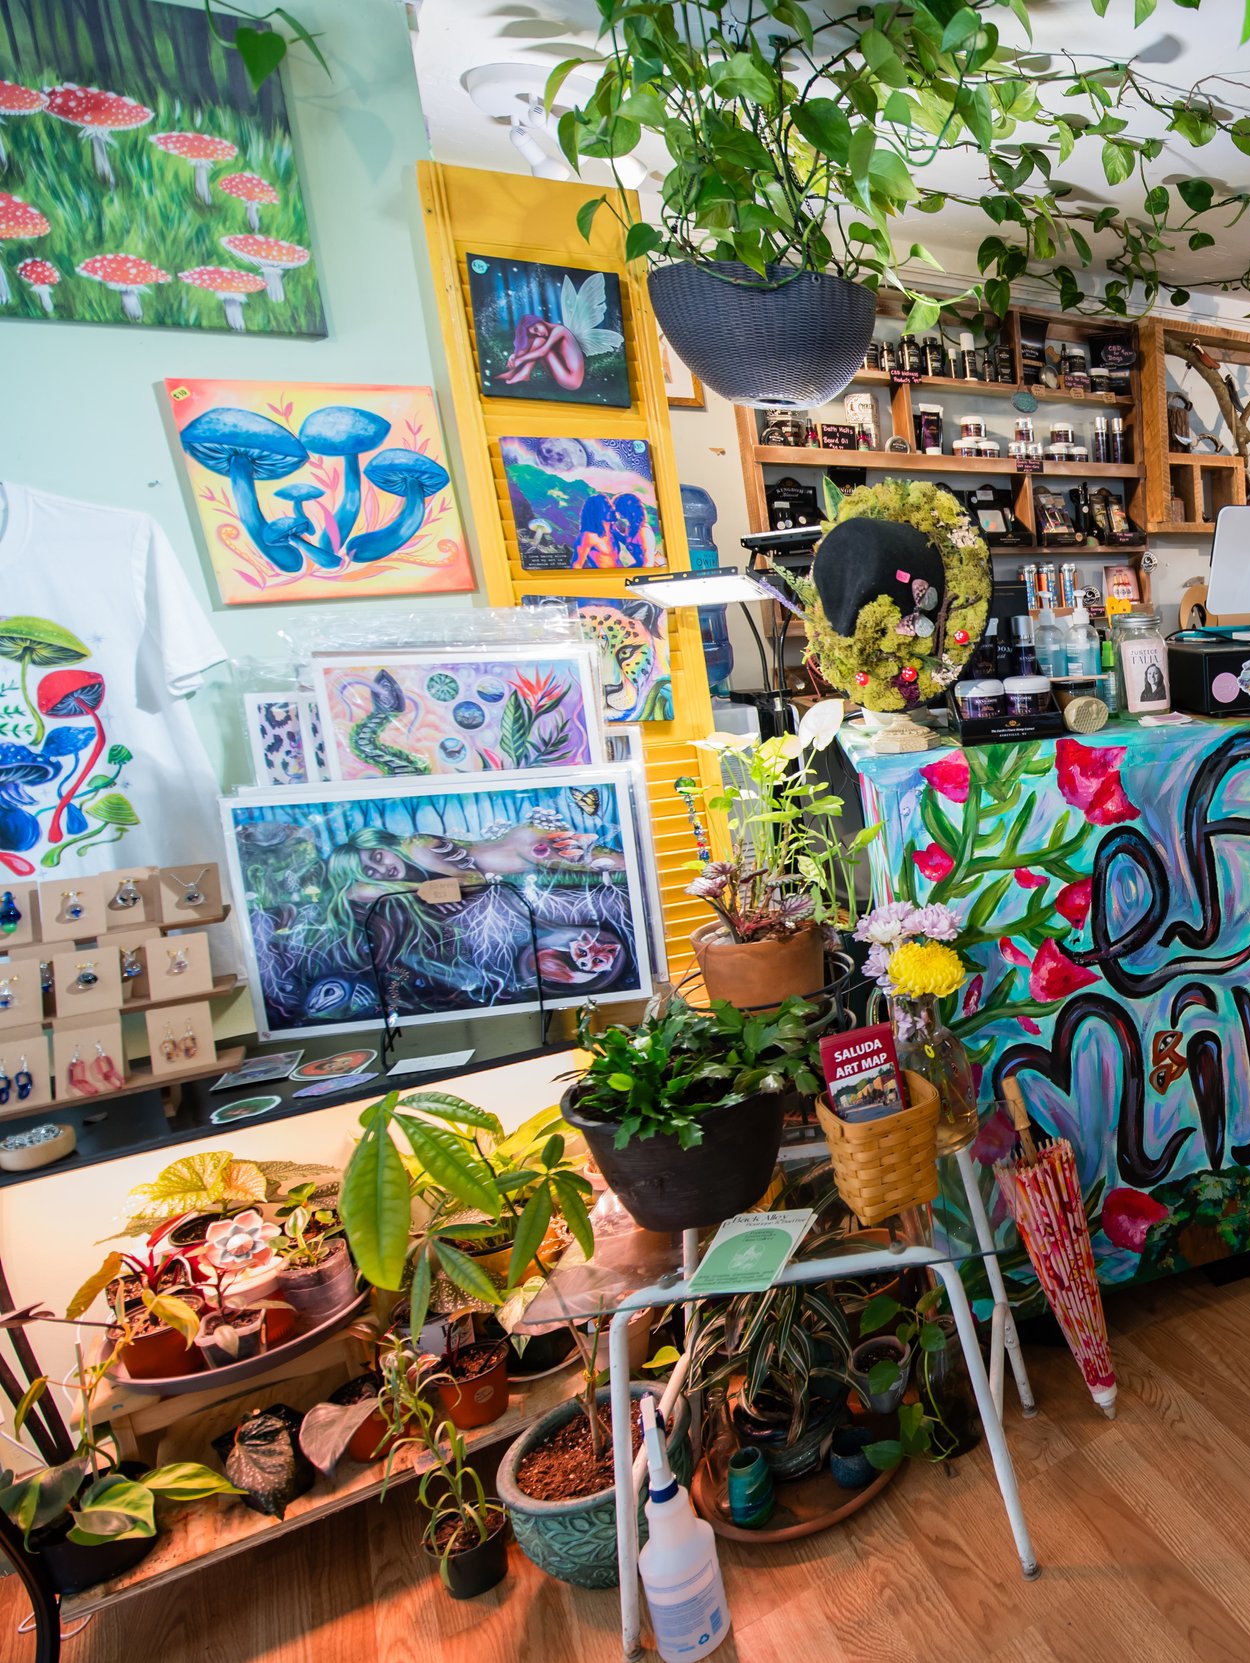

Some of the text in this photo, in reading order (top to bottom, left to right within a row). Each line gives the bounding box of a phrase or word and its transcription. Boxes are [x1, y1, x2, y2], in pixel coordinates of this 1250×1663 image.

[823, 437, 840, 445] Beard
[1130, 648, 1158, 656] JUSTICE
[833, 1038, 883, 1062] SALUDA
[835, 1052, 888, 1079] ART MAP
[732, 1215, 759, 1224] Back
[762, 1214, 790, 1222] Alley
